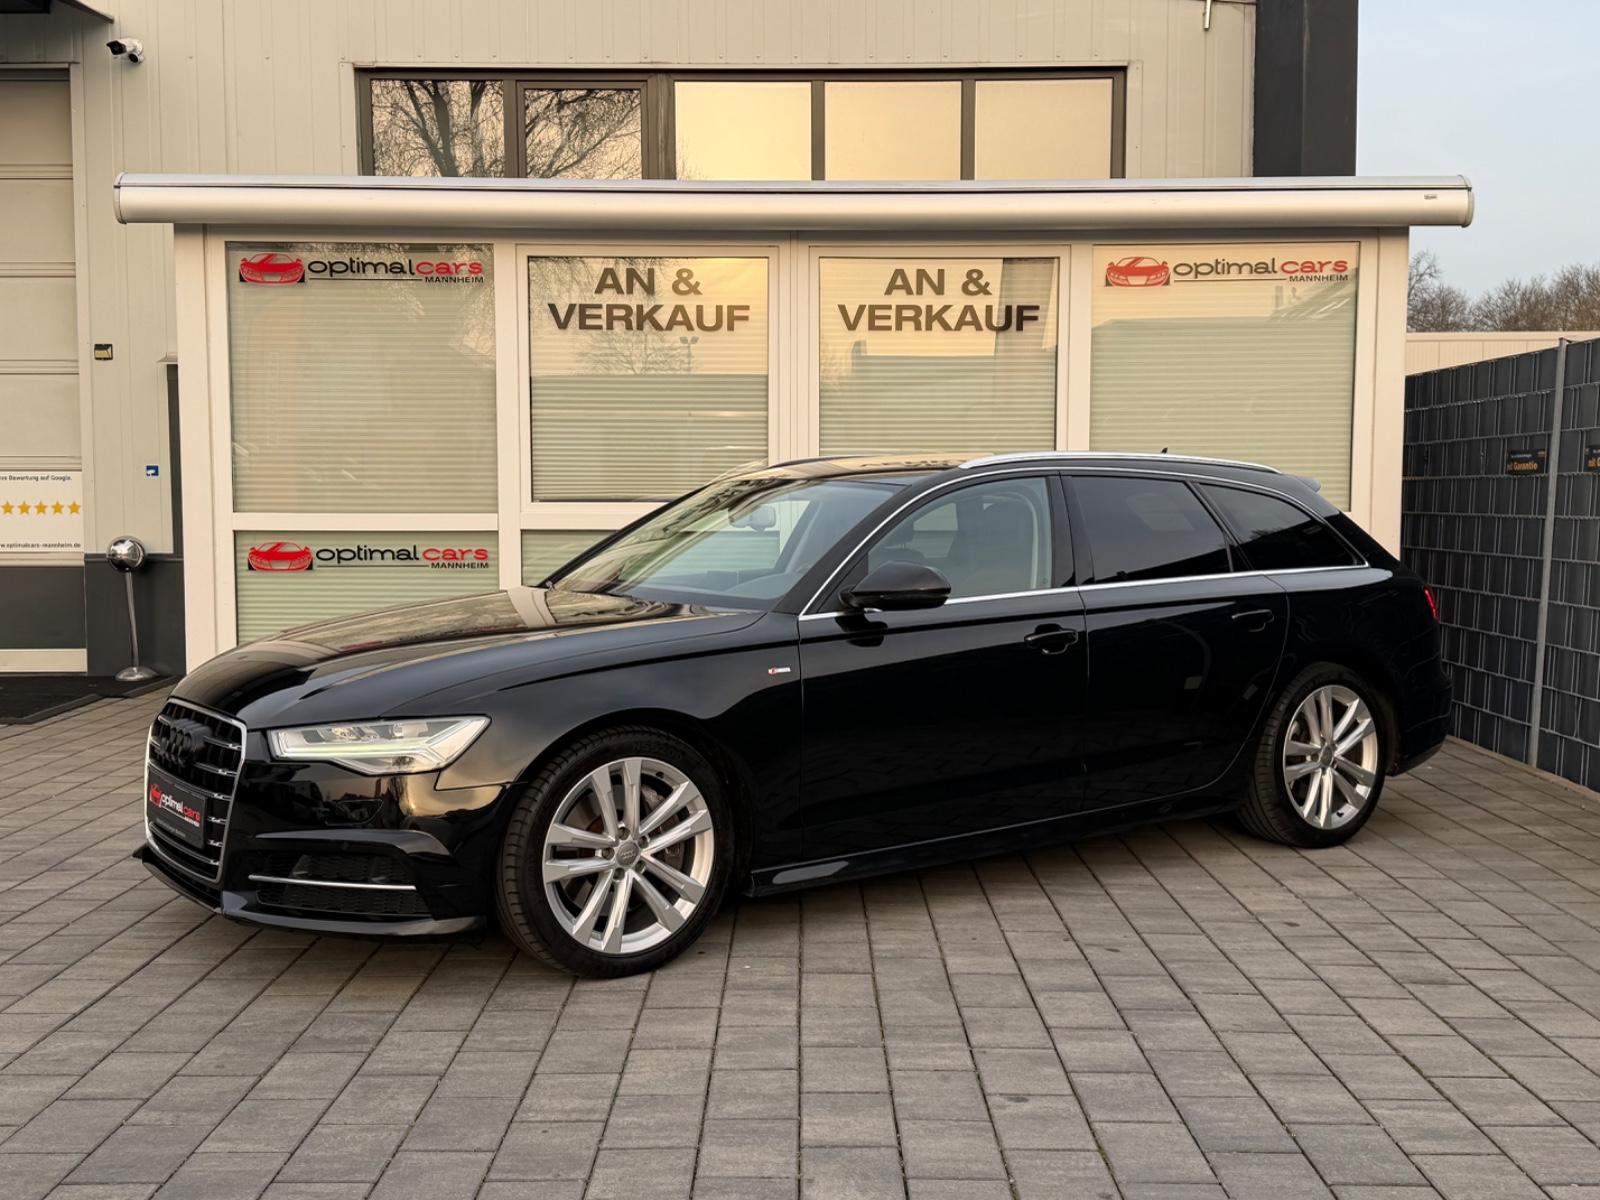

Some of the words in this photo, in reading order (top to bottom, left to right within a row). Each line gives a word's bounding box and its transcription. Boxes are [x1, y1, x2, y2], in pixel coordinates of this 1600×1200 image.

[594, 267, 655, 295] AN
[671, 268, 703, 296] &
[884, 268, 945, 296] AN
[961, 268, 993, 297] &
[1289, 274, 1349, 282] MANNHEIM
[547, 303, 751, 331] VERKAUF
[837, 304, 1040, 332] VERKAUF
